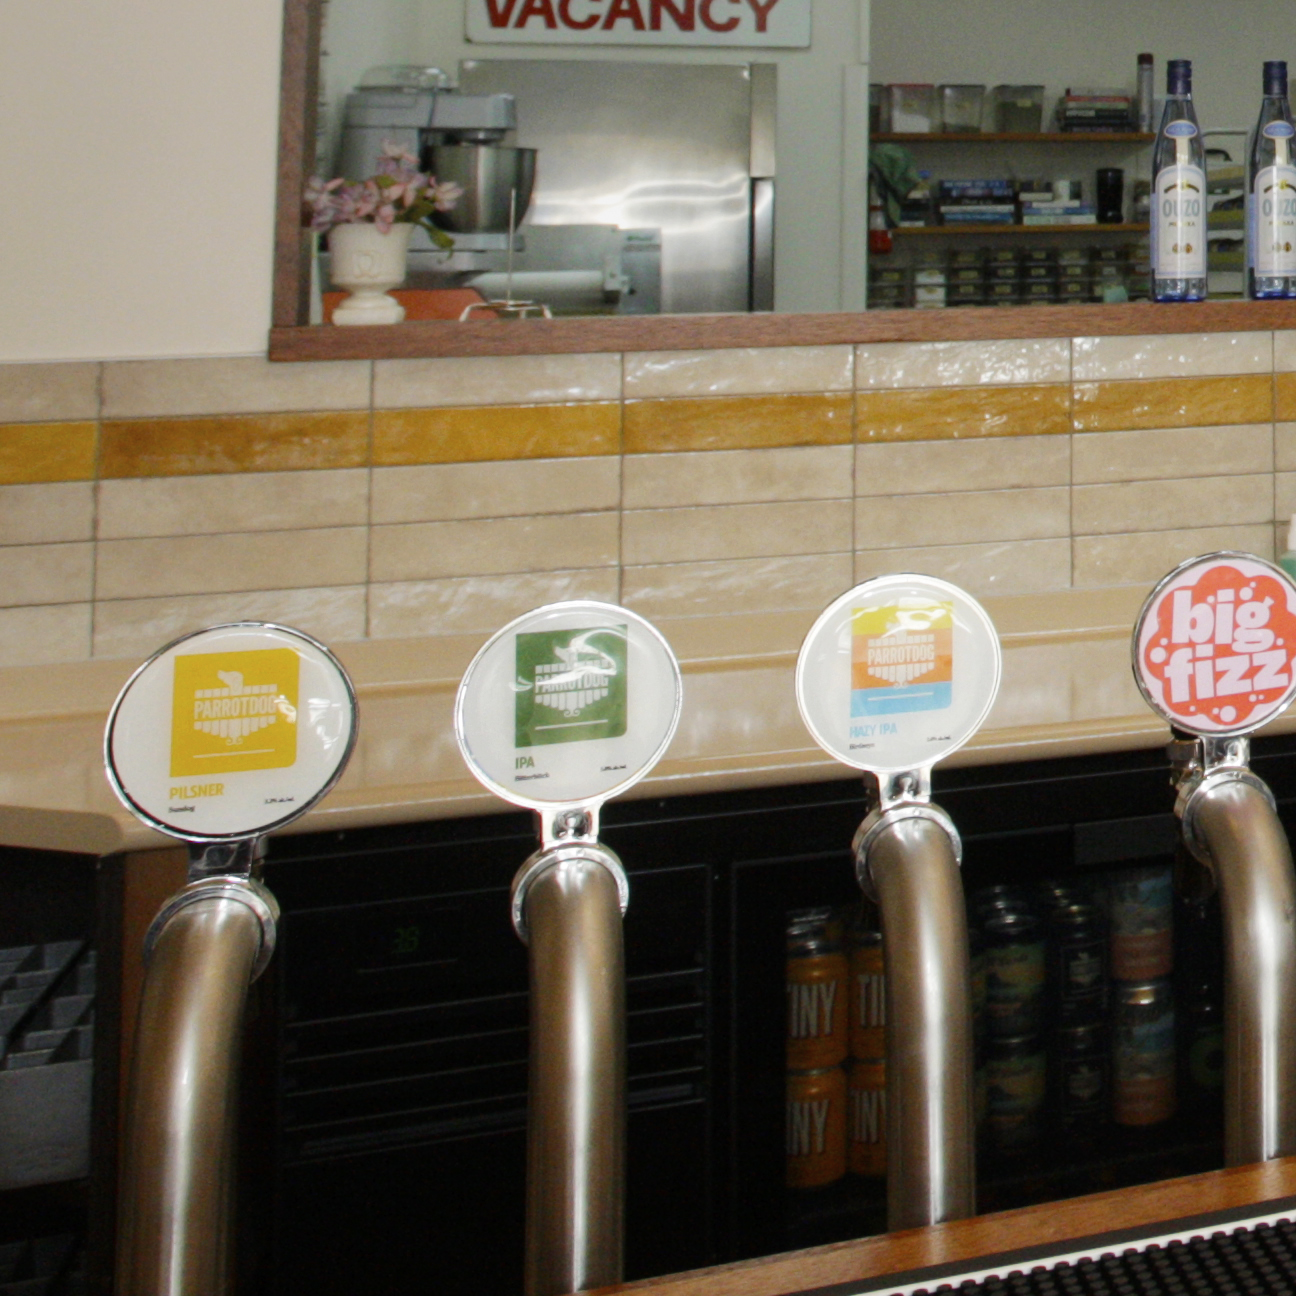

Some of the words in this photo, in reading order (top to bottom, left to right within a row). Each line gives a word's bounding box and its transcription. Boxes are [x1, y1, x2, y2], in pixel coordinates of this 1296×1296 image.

[1172, 588, 1275, 653] big
[868, 644, 935, 665] PARROTDOG
[1164, 644, 1289, 703] fizz
[194, 695, 277, 719] PARROTDOG
[849, 725, 876, 738] HAZY
[880, 723, 897, 735] IPA
[515, 756, 535, 770] IPA
[169, 783, 225, 799] PILSNER
